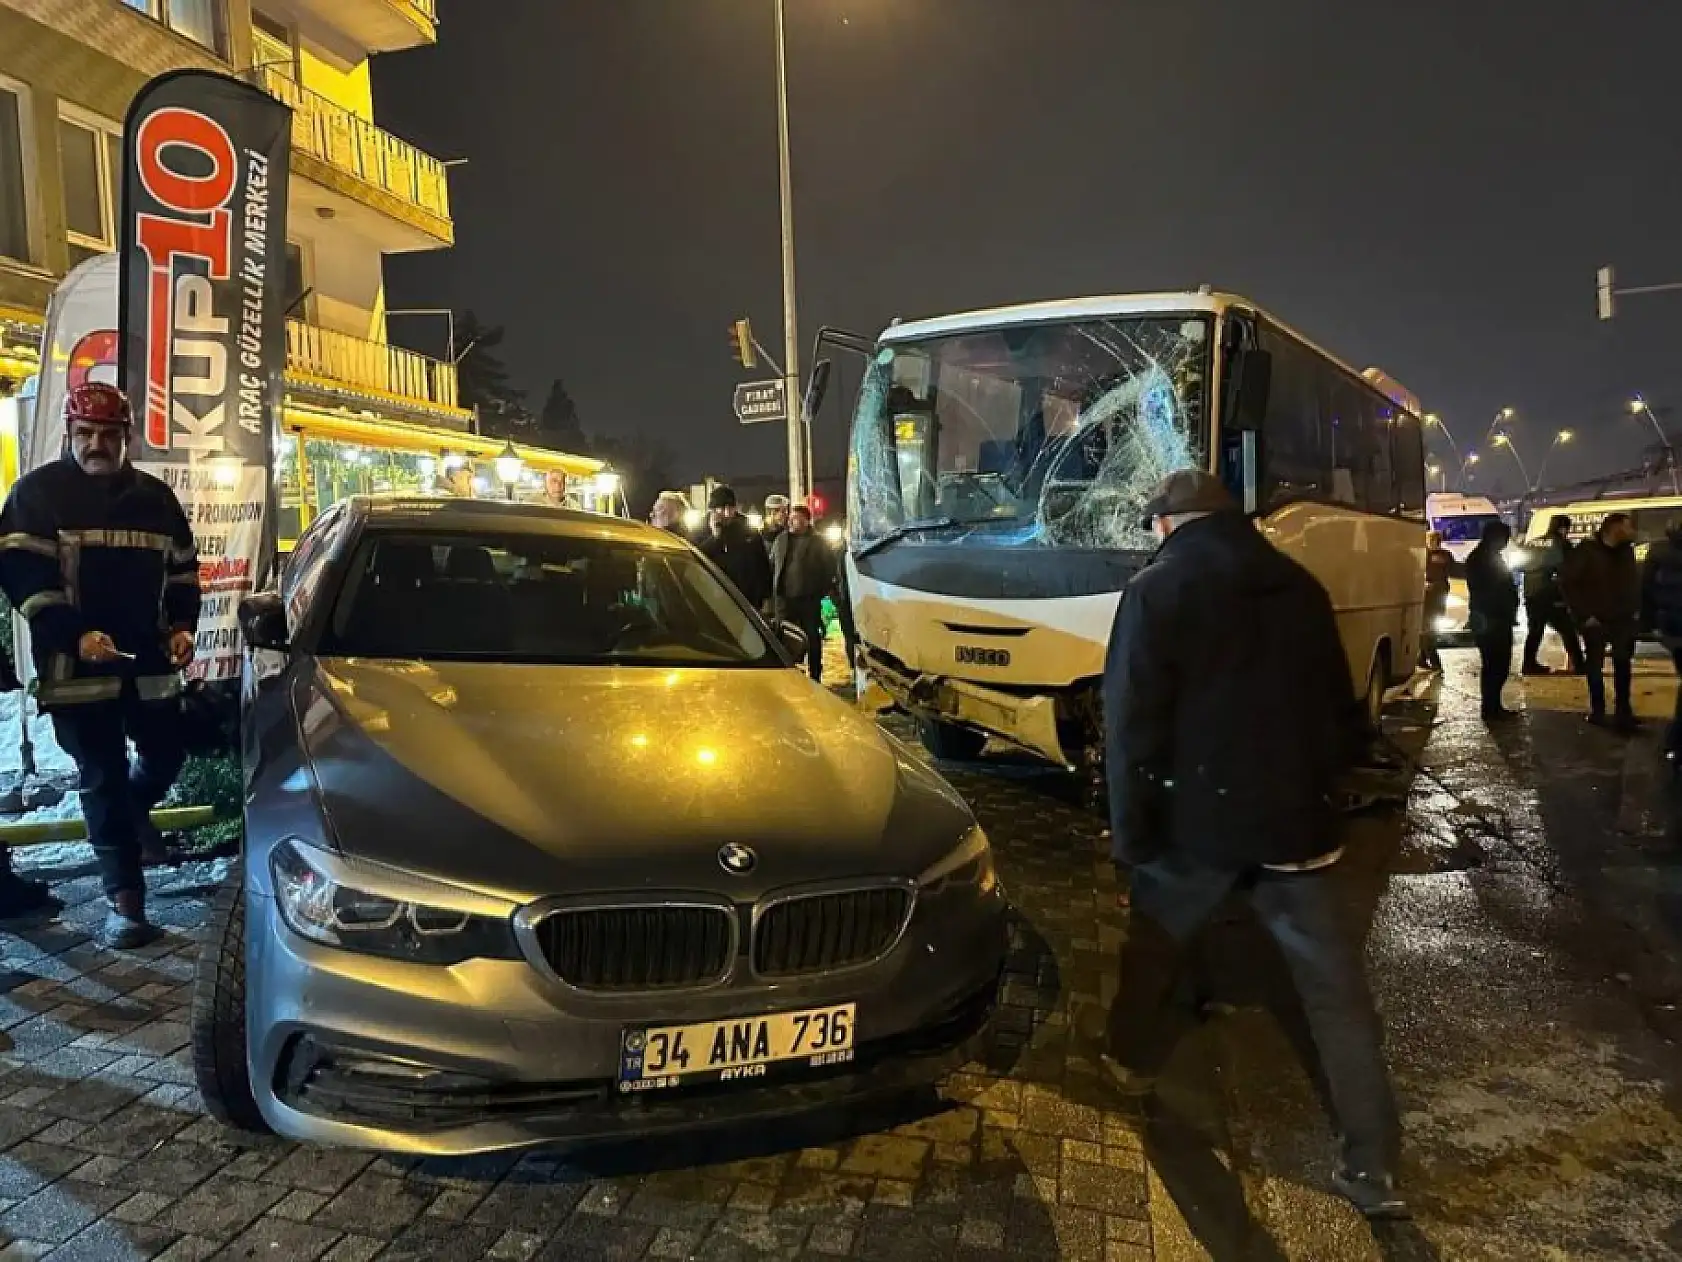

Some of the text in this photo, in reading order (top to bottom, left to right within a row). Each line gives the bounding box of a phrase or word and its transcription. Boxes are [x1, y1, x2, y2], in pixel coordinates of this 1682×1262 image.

[236, 147, 270, 434] ARAÇ GÜZELLİK MERKEZİ
[954, 645, 1010, 667] IVECO
[647, 1030, 690, 1071] 34
[709, 1020, 770, 1065] ANA
[791, 1009, 850, 1053] 736
